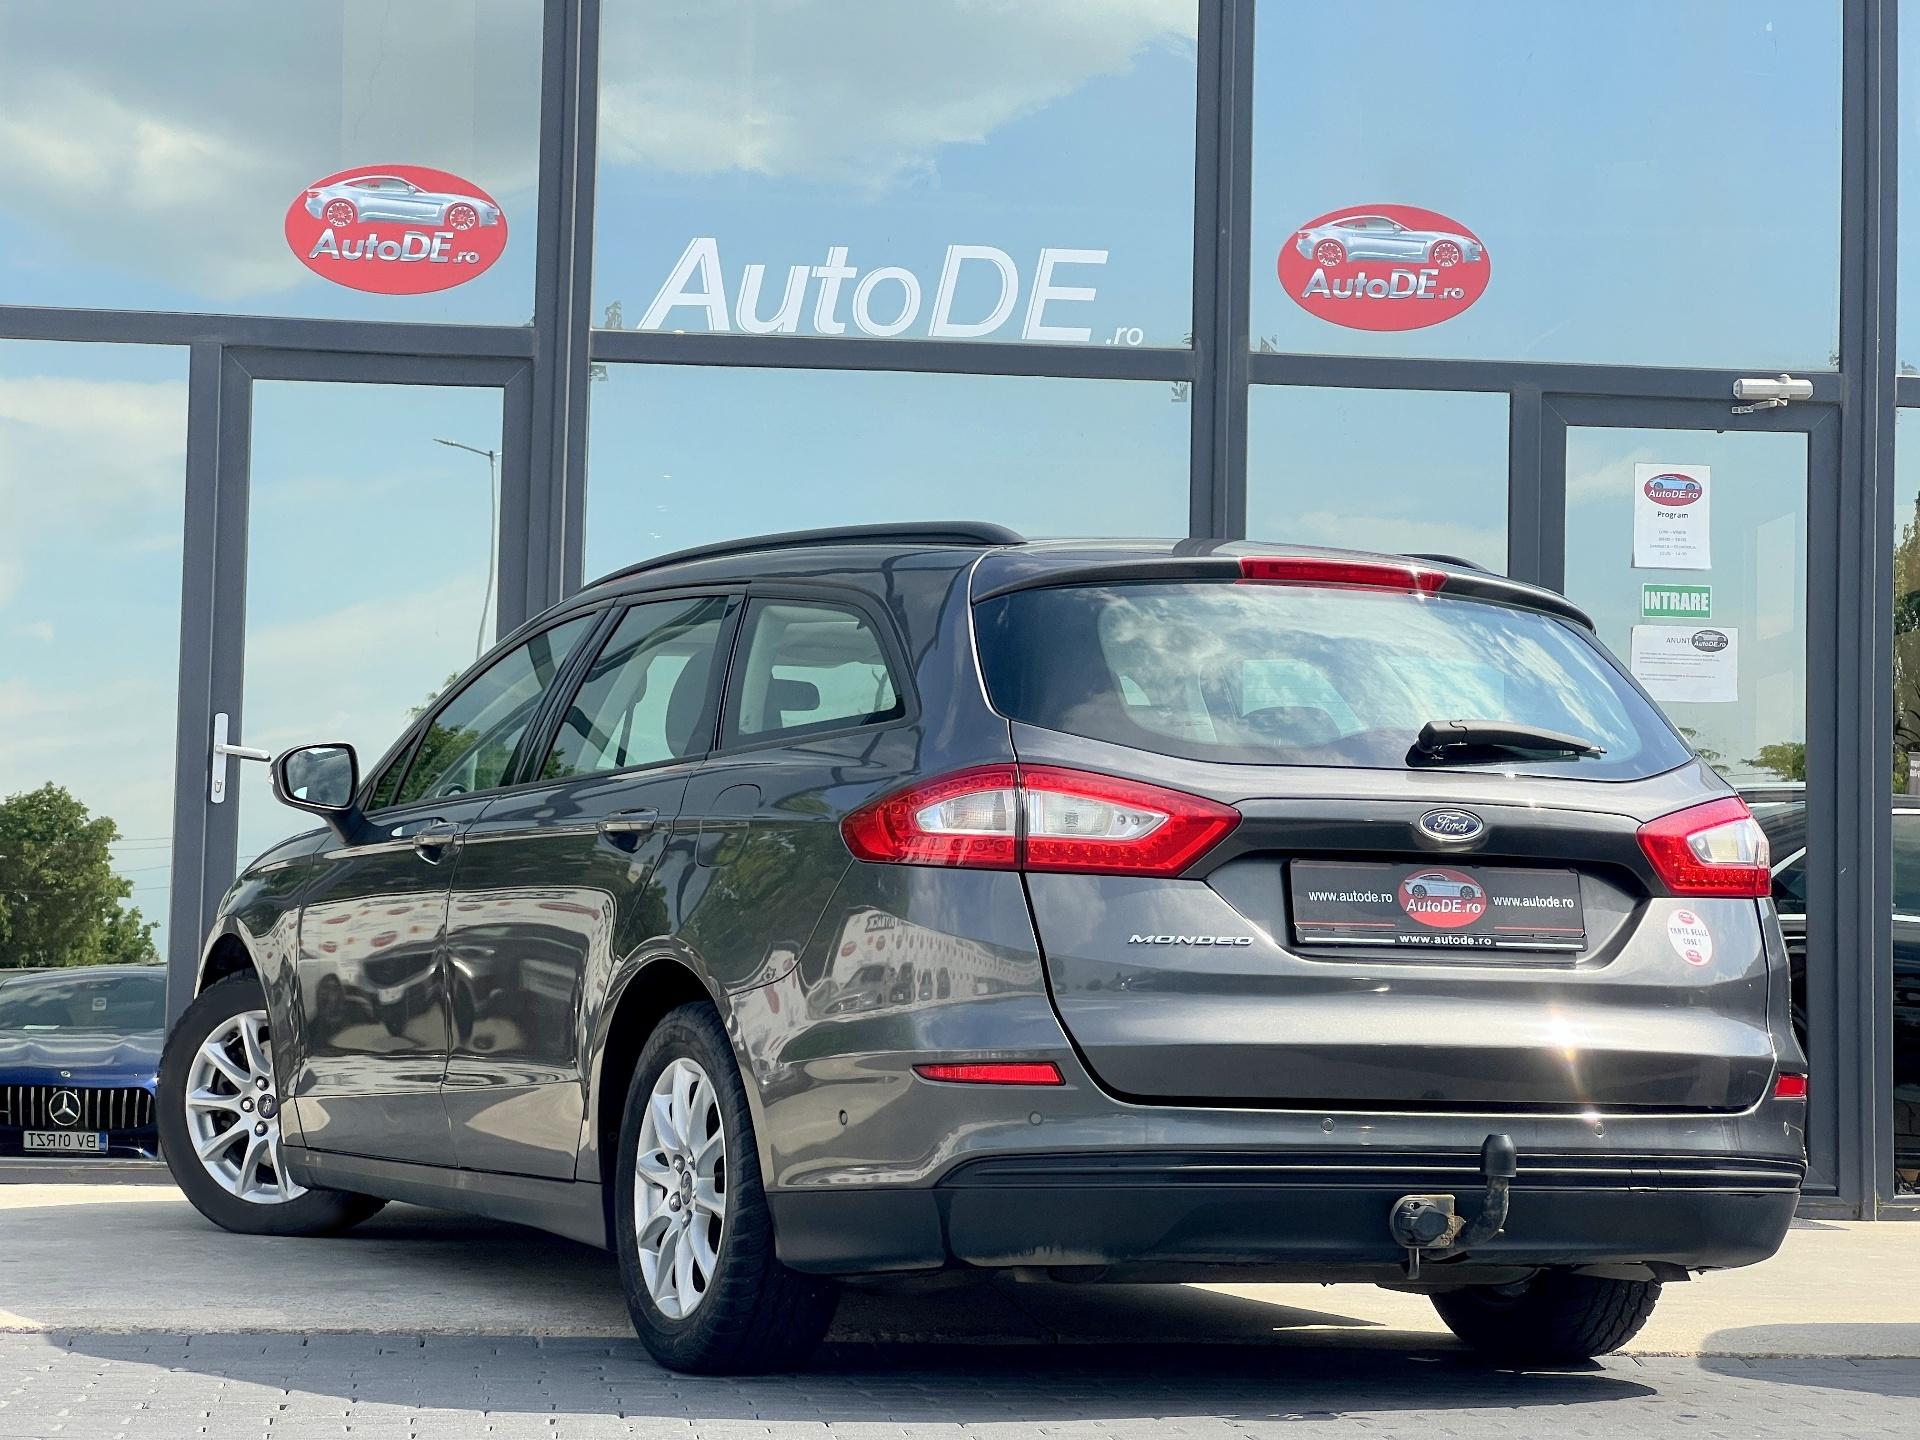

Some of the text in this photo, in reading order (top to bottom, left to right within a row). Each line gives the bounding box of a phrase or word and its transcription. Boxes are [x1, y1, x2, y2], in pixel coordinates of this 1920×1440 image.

[1648, 489, 1699, 499] AutoDE.ro
[1657, 511, 1689, 519] Program
[1644, 591, 1709, 611] INTRARE
[1434, 814, 1468, 832] Ford
[1308, 889, 1393, 903] www.autode.ro
[1493, 895, 1574, 909] www.autode.ro
[1406, 899, 1481, 914] AutoDE.ro
[1128, 934, 1255, 946] MONDEO
[1399, 934, 1492, 946] www.autode.ro
